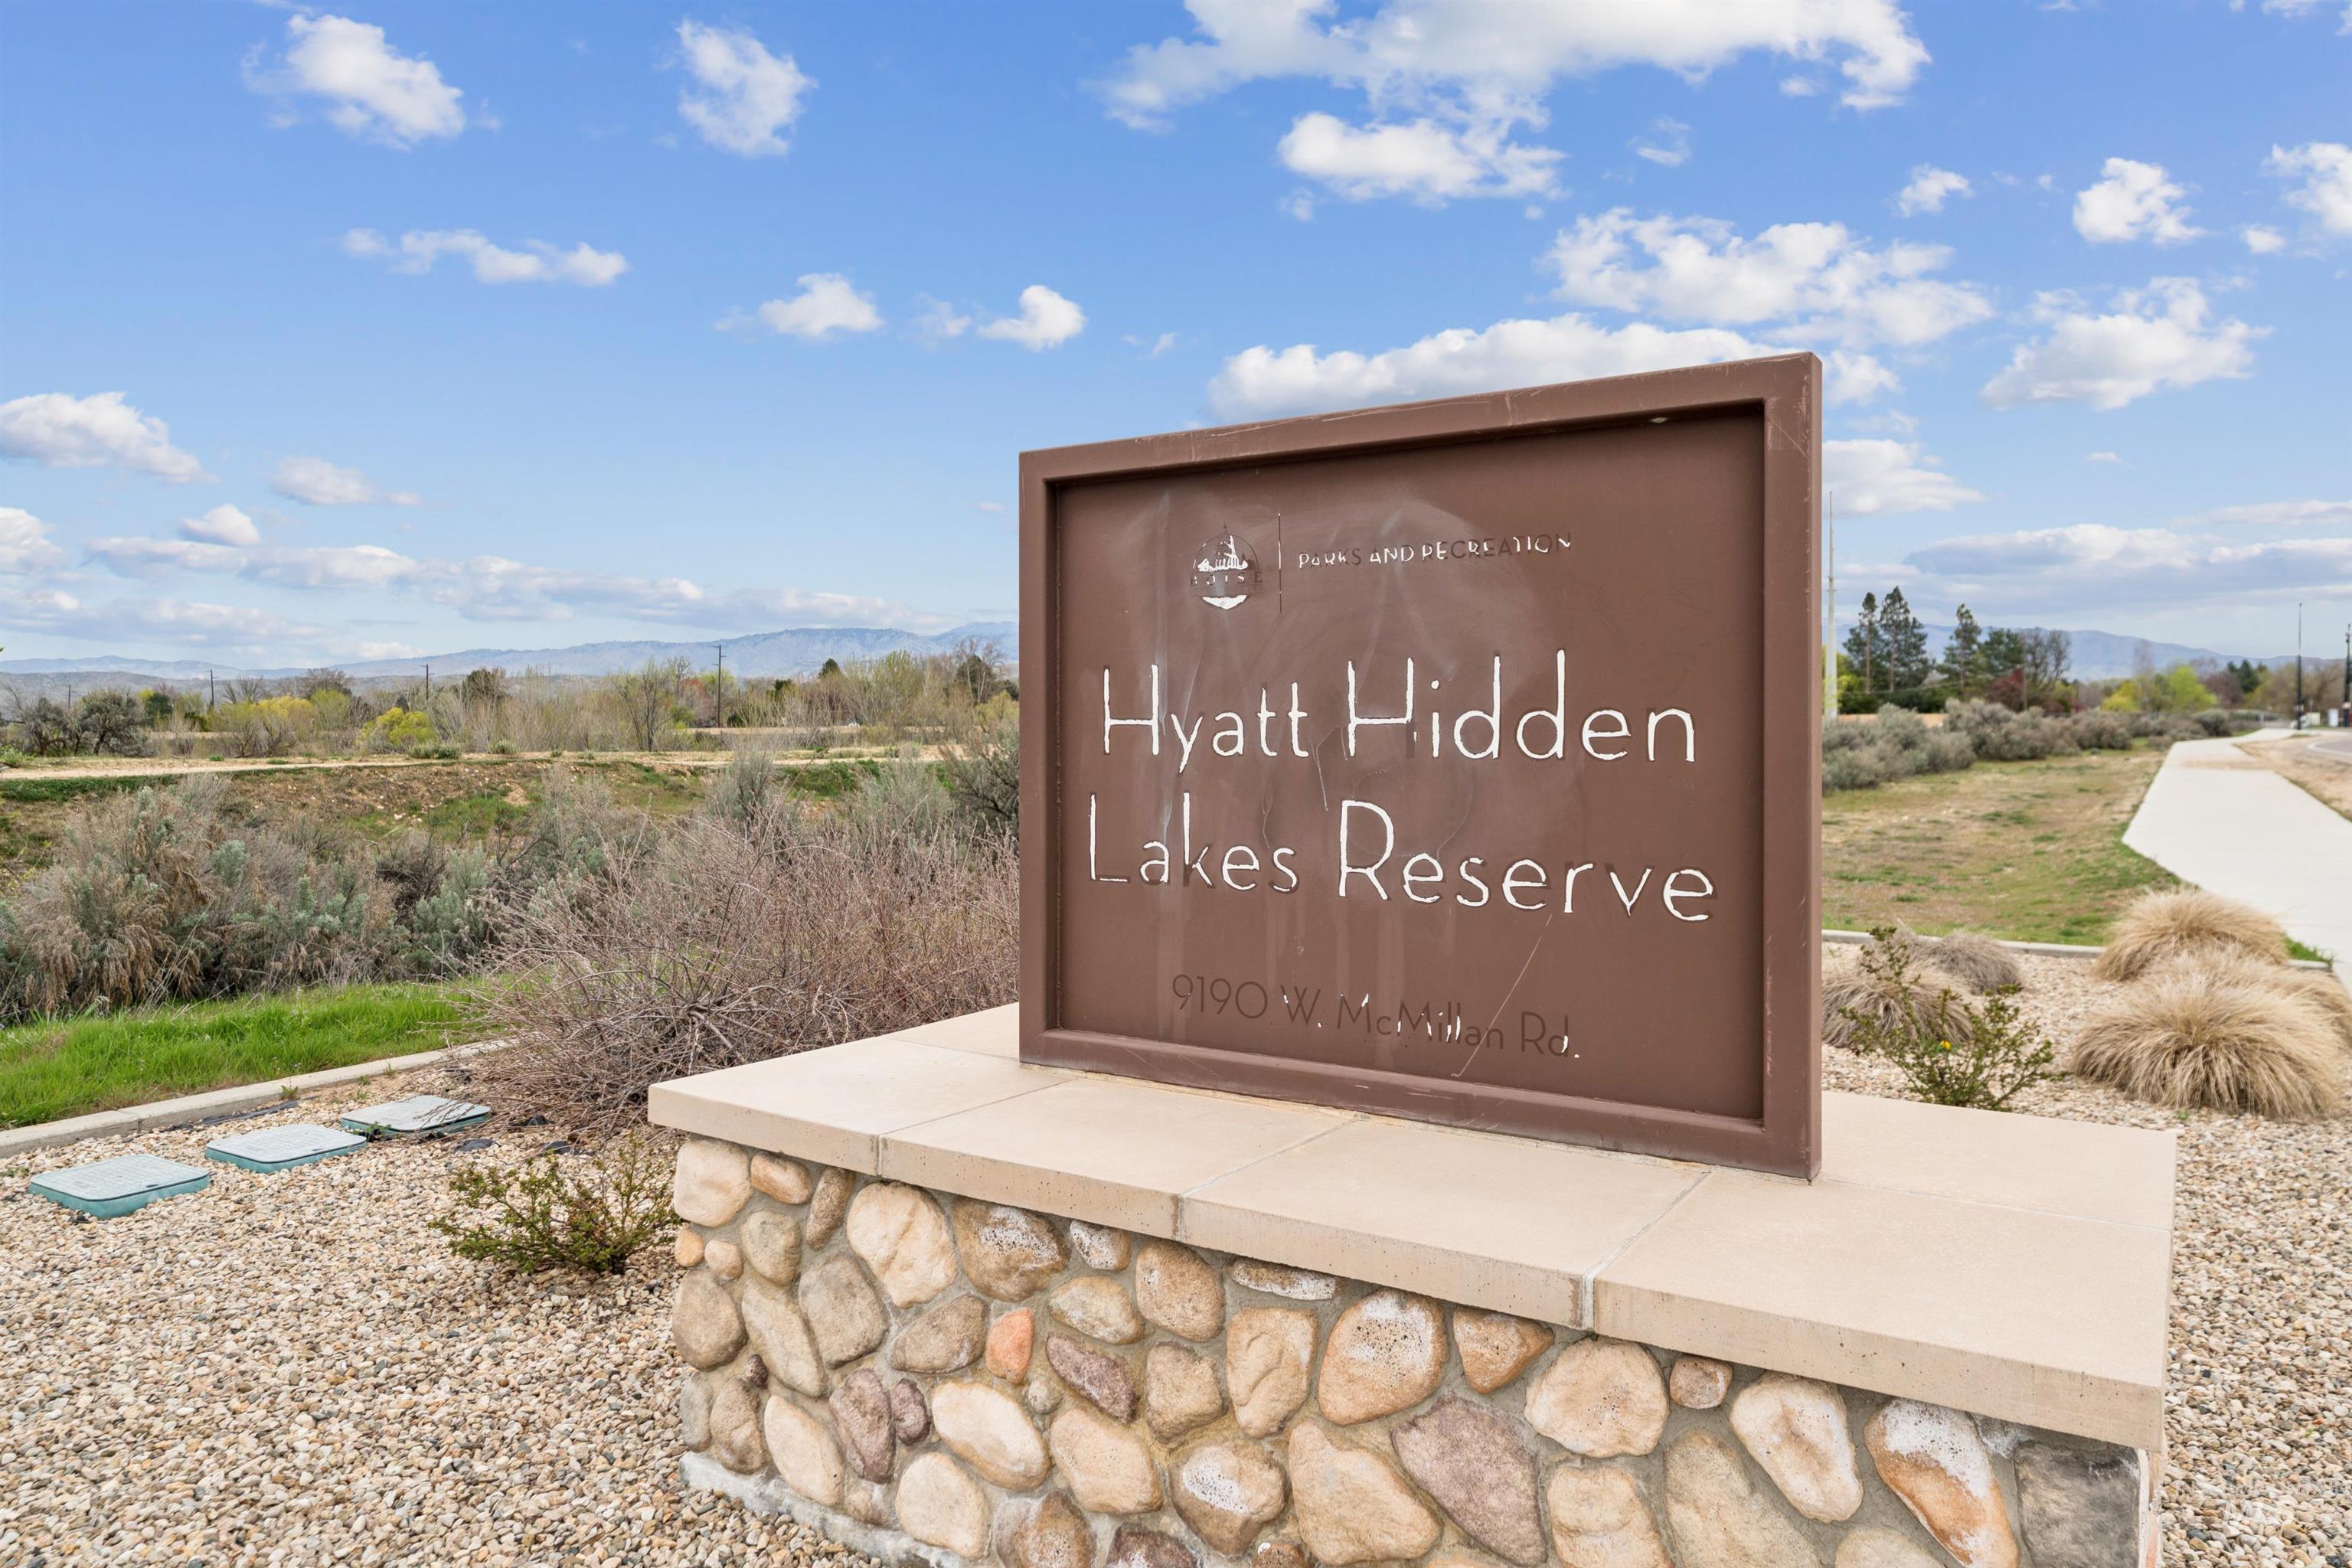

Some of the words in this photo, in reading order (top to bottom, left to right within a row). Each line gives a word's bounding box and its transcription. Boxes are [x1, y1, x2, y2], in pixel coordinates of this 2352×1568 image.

[1191, 571, 1263, 587] BOISE
[1299, 547, 1361, 568] PARKS
[1370, 544, 1415, 564] AND
[1422, 532, 1572, 562] RECREATION
[1103, 663, 1310, 773] Hyatt
[1346, 649, 1696, 763] Hidden
[1089, 792, 1299, 892] Lakes
[1338, 799, 1716, 921] Reserve
[1172, 974, 1268, 1019] 9190
[1281, 985, 1323, 1027] W.
[1337, 993, 1504, 1050] McMillan
[1521, 1011, 1579, 1059] Rd.
